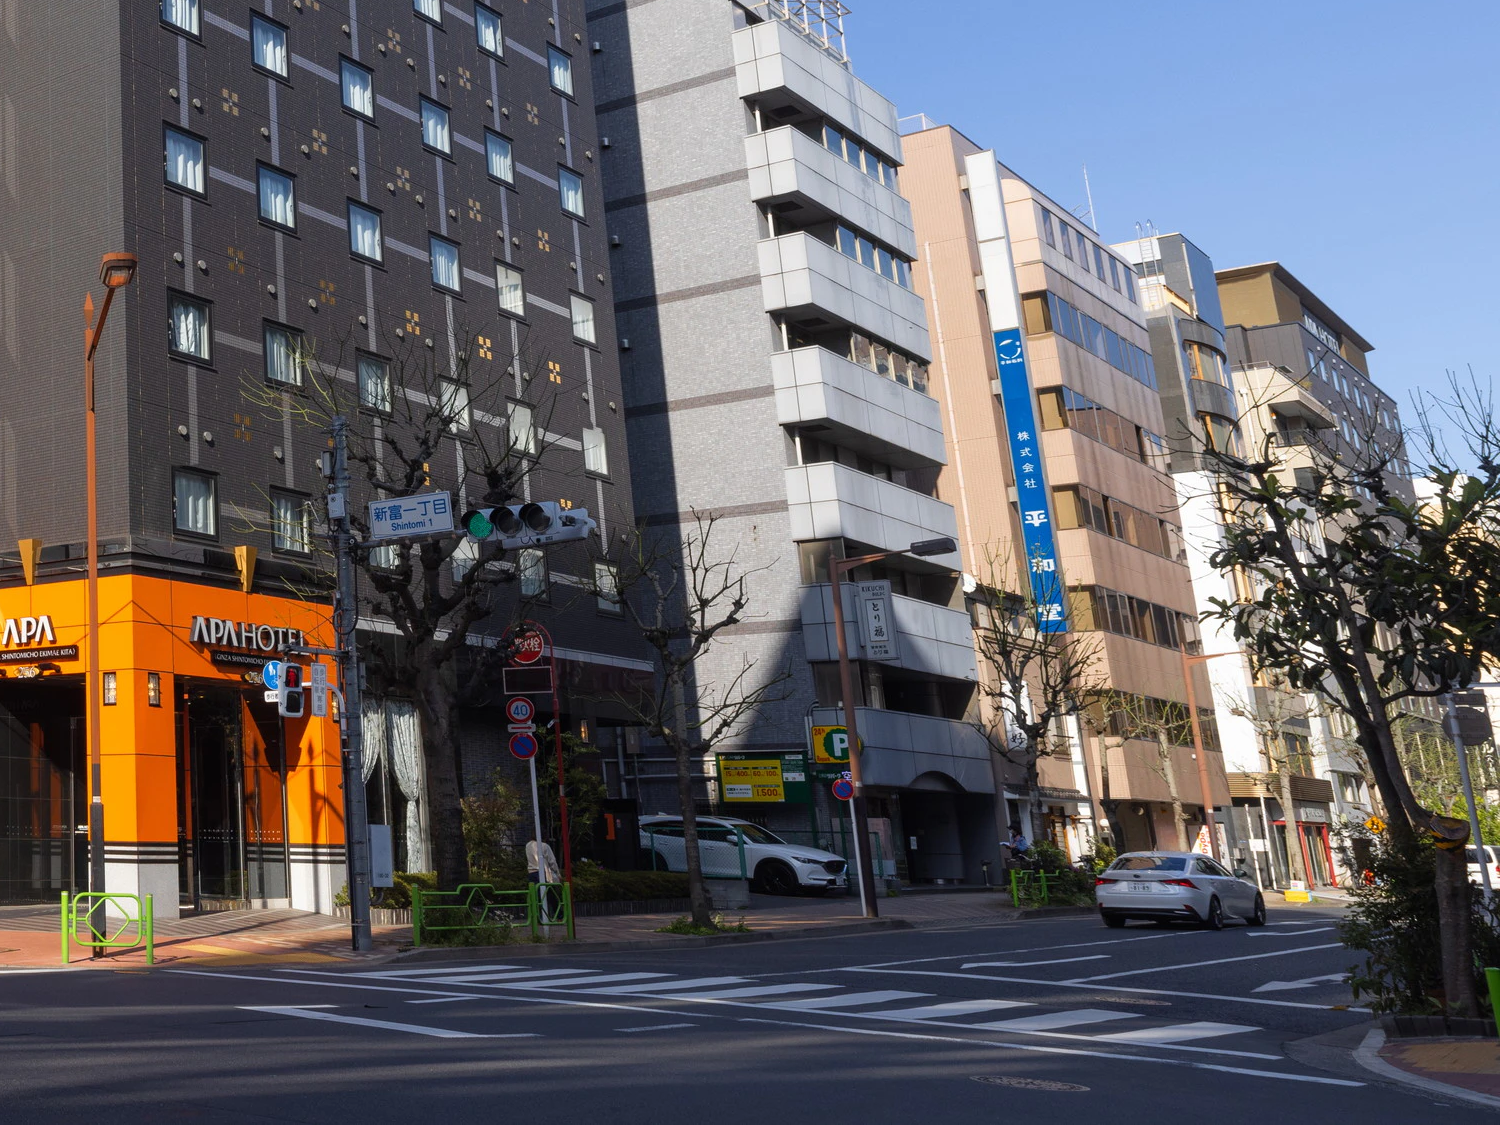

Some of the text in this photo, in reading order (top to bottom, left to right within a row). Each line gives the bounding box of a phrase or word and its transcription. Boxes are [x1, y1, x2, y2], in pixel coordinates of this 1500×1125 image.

[1017, 431, 1038, 489] 株式会社
[373, 498, 447, 522] 新富一丁目
[391, 518, 433, 532] Shintomi 1
[2, 615, 56, 647] APA
[190, 616, 238, 647] APA
[872, 602, 885, 637] とり福
[1, 650, 39, 661] SHINTOMICHO
[40, 649, 60, 658] EKIMAE
[513, 704, 529, 716] 40
[832, 733, 850, 757] P
[1200, 832, 1209, 854] DyDo
